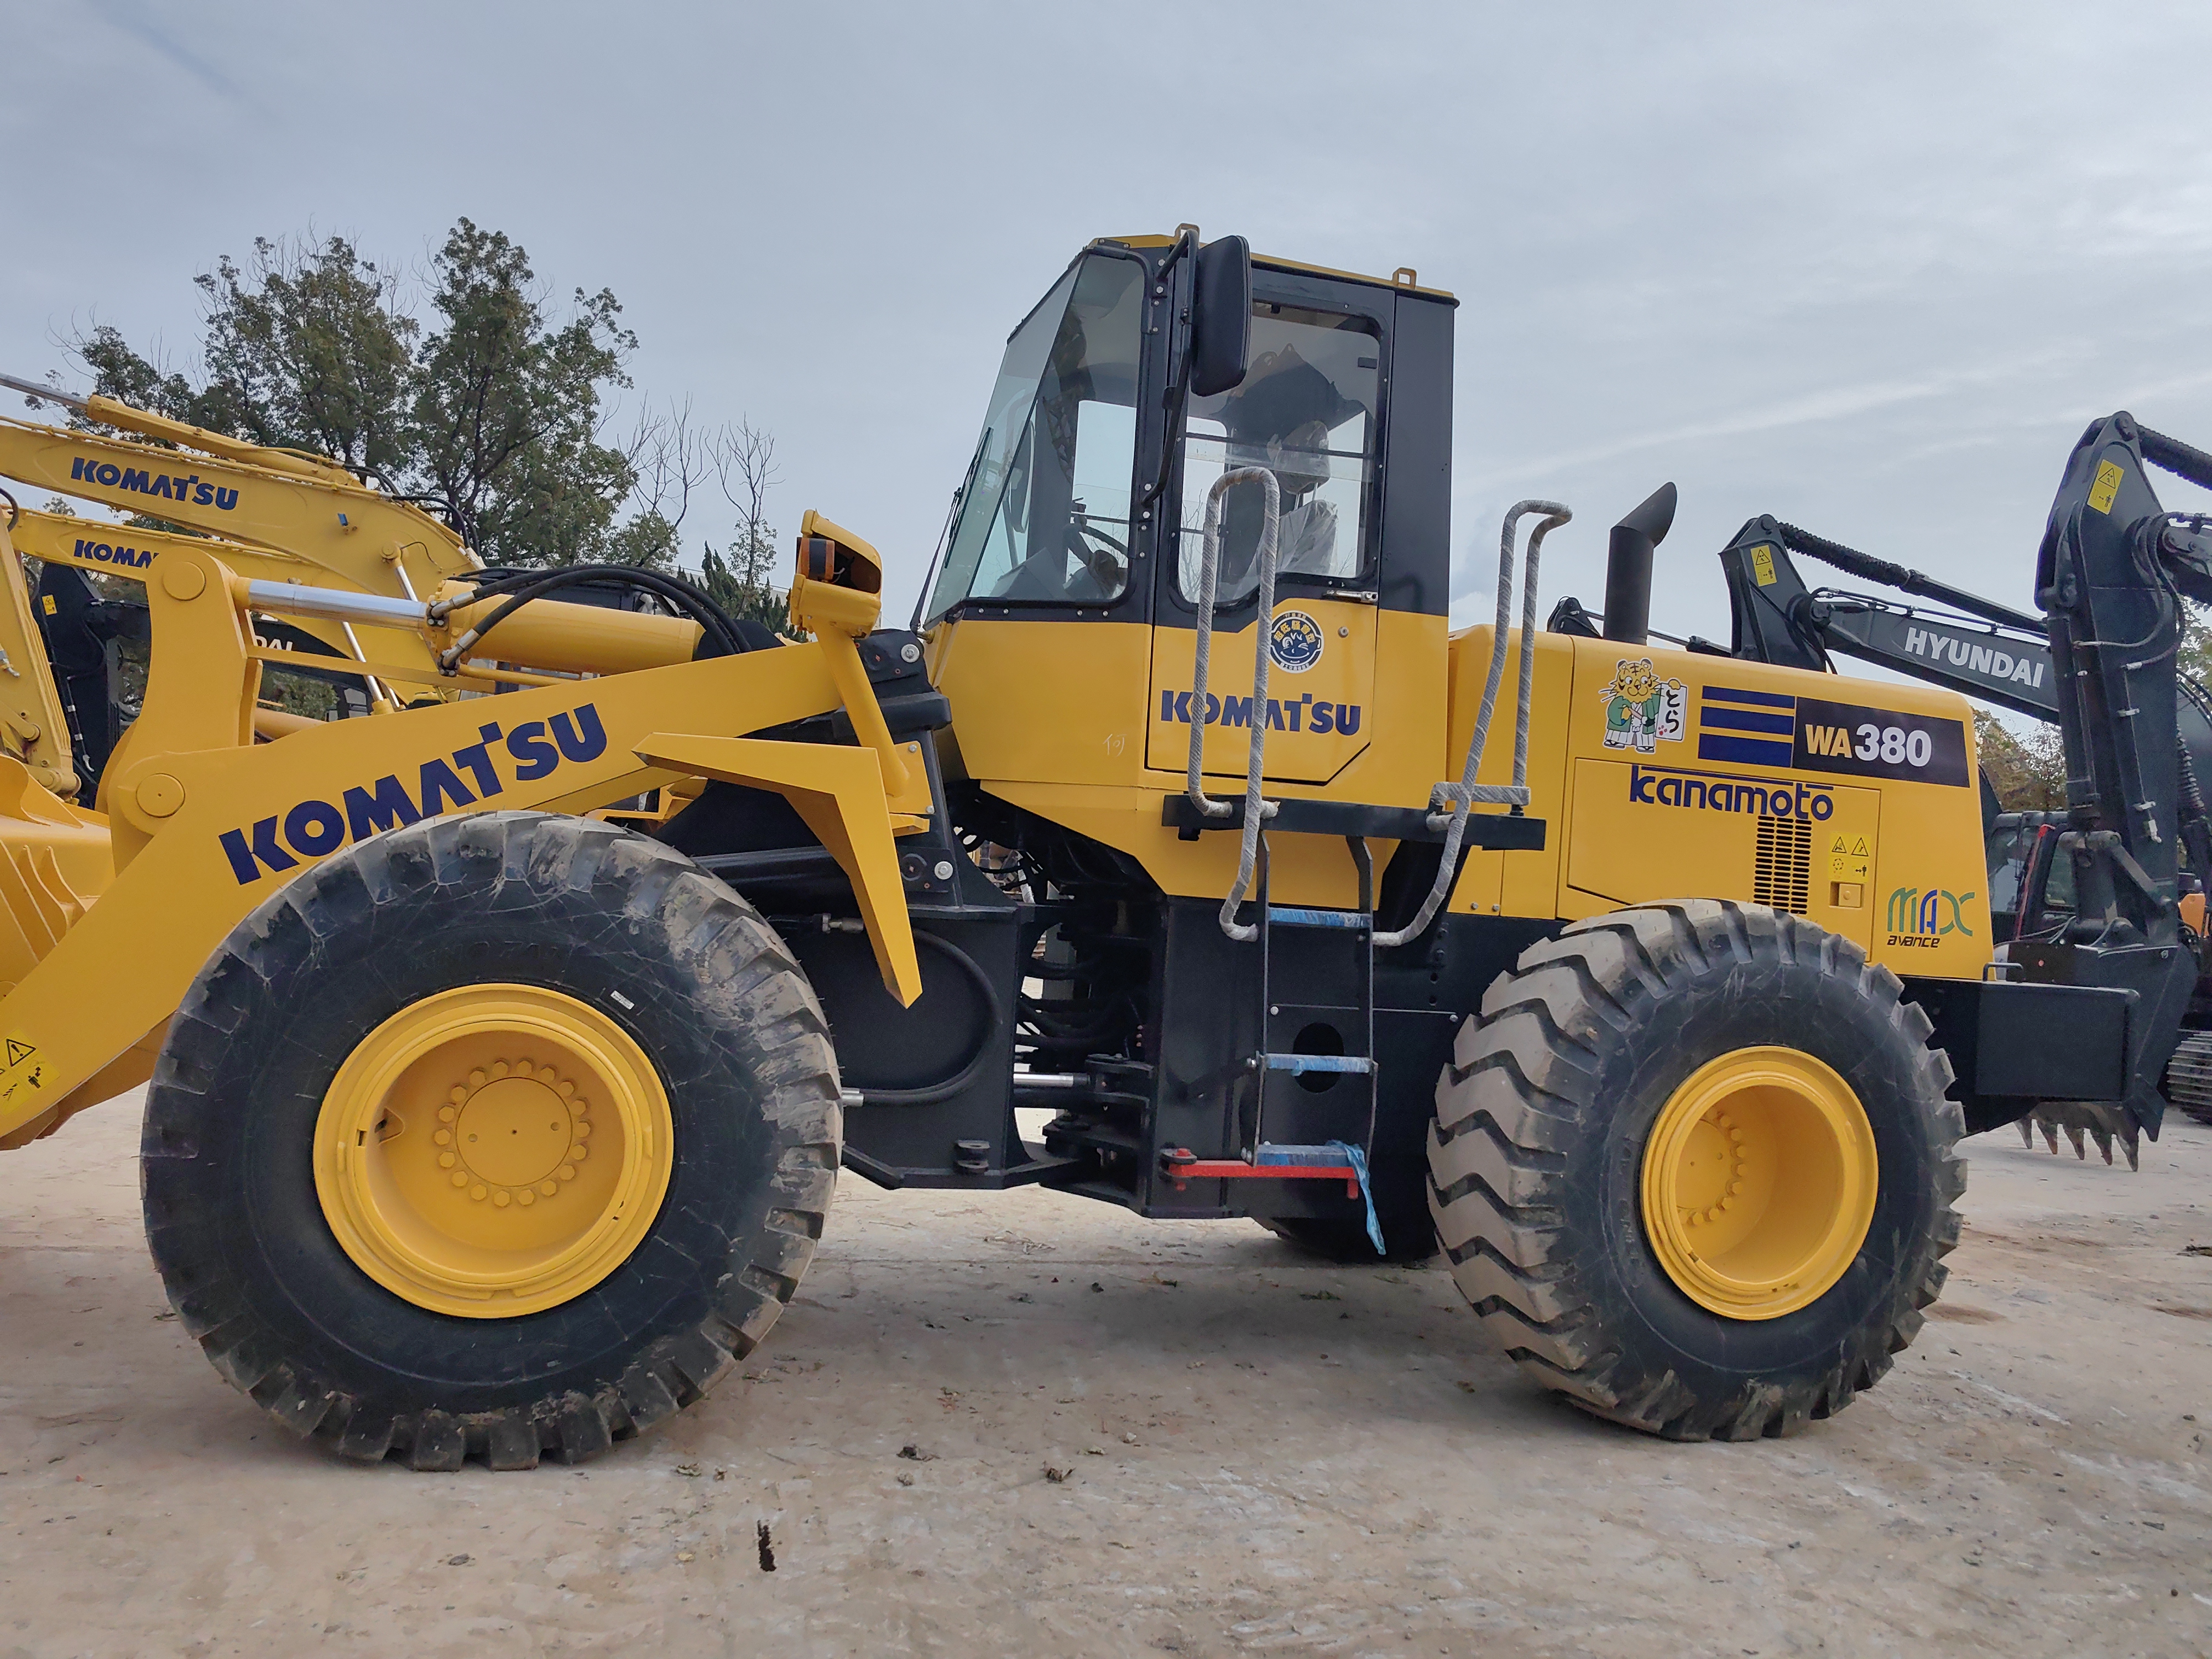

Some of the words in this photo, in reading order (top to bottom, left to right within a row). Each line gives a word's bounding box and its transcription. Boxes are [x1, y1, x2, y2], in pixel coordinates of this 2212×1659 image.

[71, 457, 239, 510] KOMATSU
[74, 539, 159, 569] KOMA
[1905, 627, 2044, 688] HYUNDAI
[1161, 690, 1361, 736] KOMATSU
[1666, 689, 1680, 733] とら
[1805, 723, 1932, 767] WA380
[218, 703, 607, 885] KOMATSU
[1629, 764, 1834, 821] kanamoto
[1887, 887, 1975, 937] MAX
[1887, 935, 1940, 948] avance
